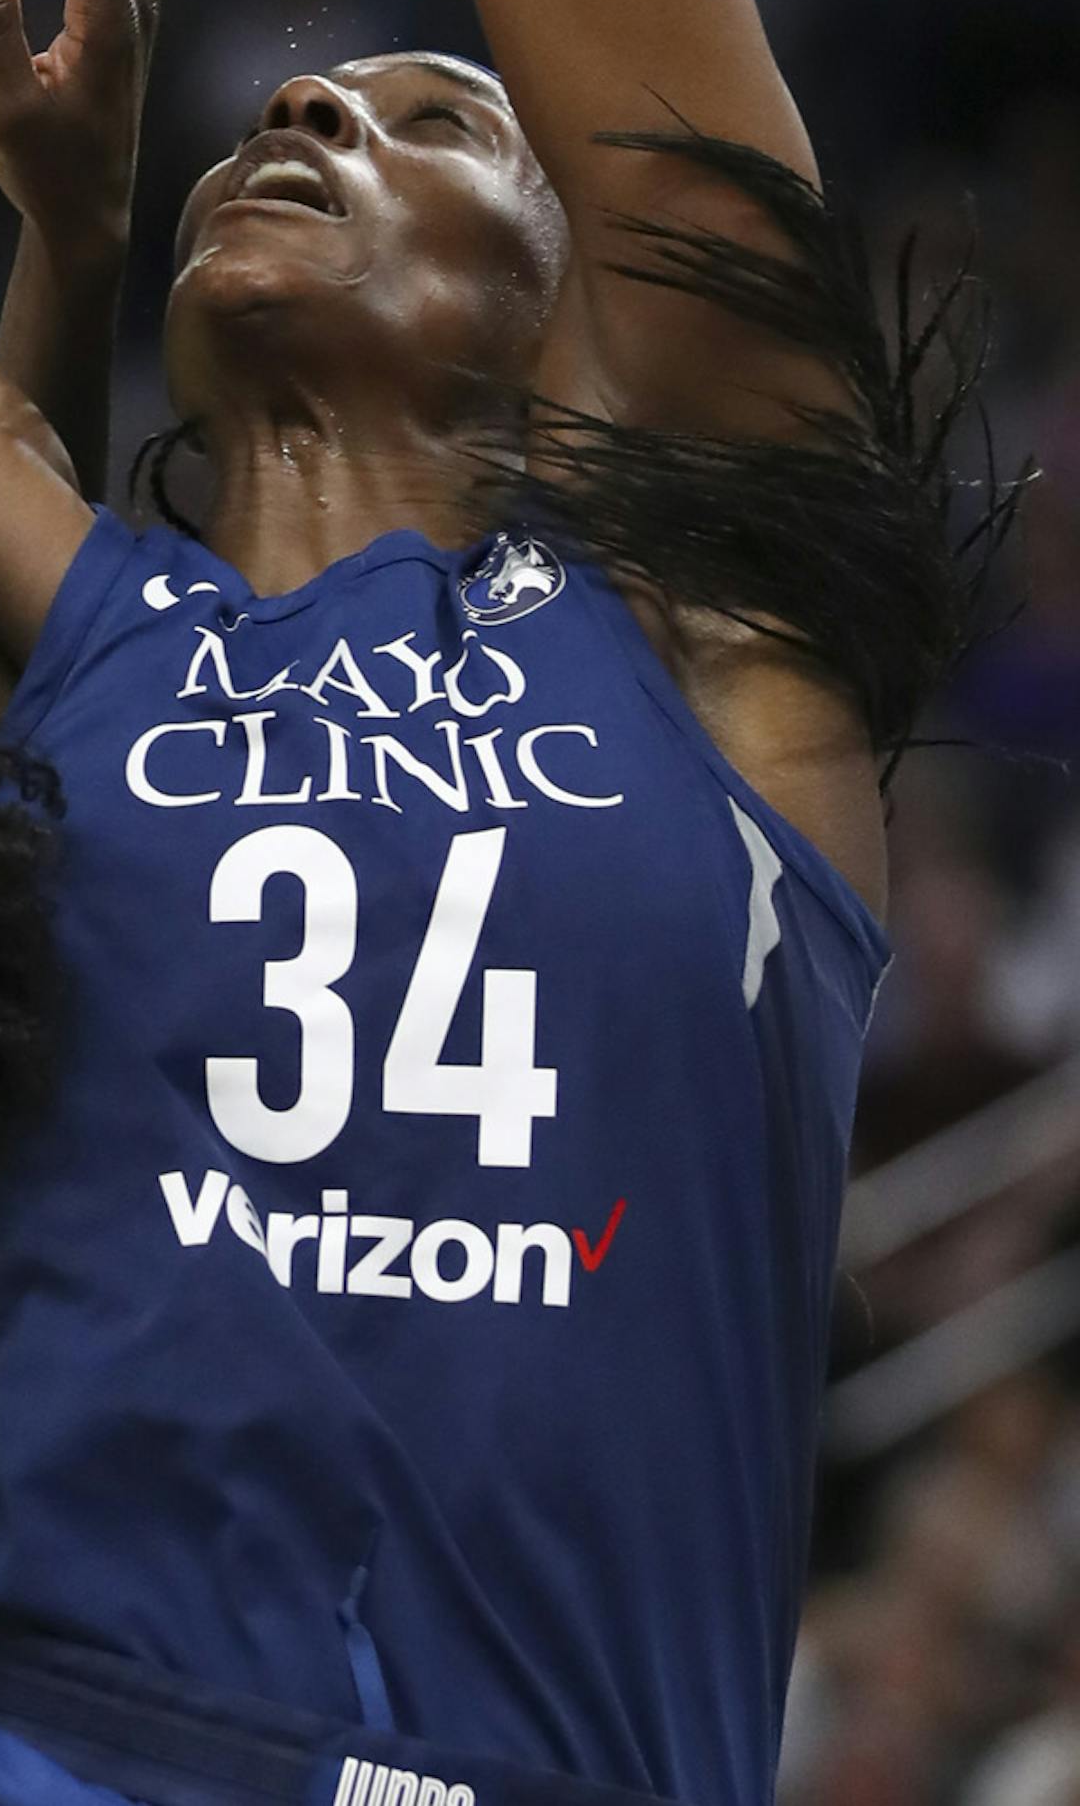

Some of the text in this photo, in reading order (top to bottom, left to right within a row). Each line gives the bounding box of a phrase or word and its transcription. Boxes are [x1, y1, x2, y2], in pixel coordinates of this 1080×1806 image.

[176, 614, 526, 719] MAYO
[125, 710, 624, 813] CLINIC
[205, 824, 558, 1169] 34
[158, 1169, 573, 1308] verizon
